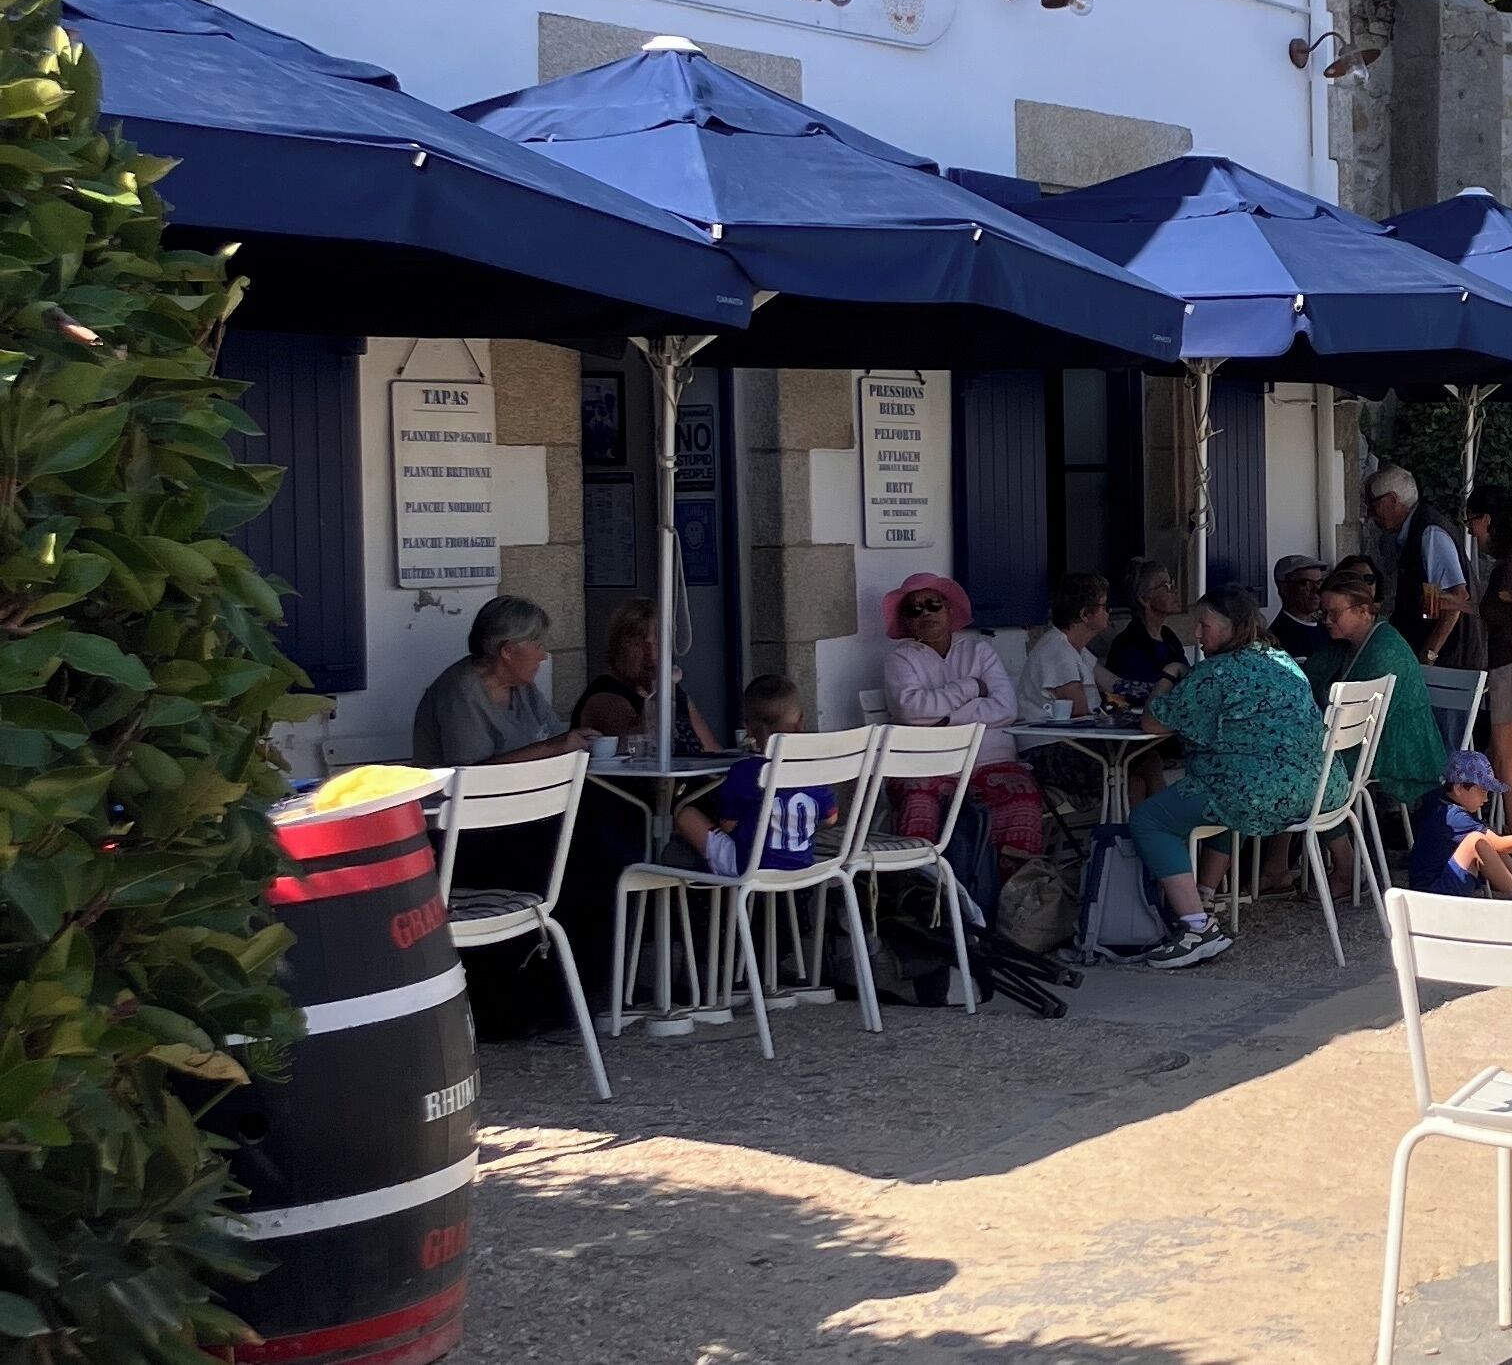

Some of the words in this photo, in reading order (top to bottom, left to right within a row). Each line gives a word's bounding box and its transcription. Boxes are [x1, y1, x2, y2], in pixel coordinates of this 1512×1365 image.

[422, 389, 469, 406] TAPAS
[869, 384, 924, 399] PRESSIONS
[879, 400, 915, 416] BIÈRES
[401, 430, 441, 443] PLANCHE
[443, 431, 492, 444] ESPAGNOLE
[677, 422, 711, 452] NO
[404, 466, 443, 478] PLANCHE
[405, 501, 445, 513] PLANCHE
[885, 528, 916, 542] CIDRE
[402, 537, 443, 549] PLANCHE
[770, 792, 818, 851] 10
